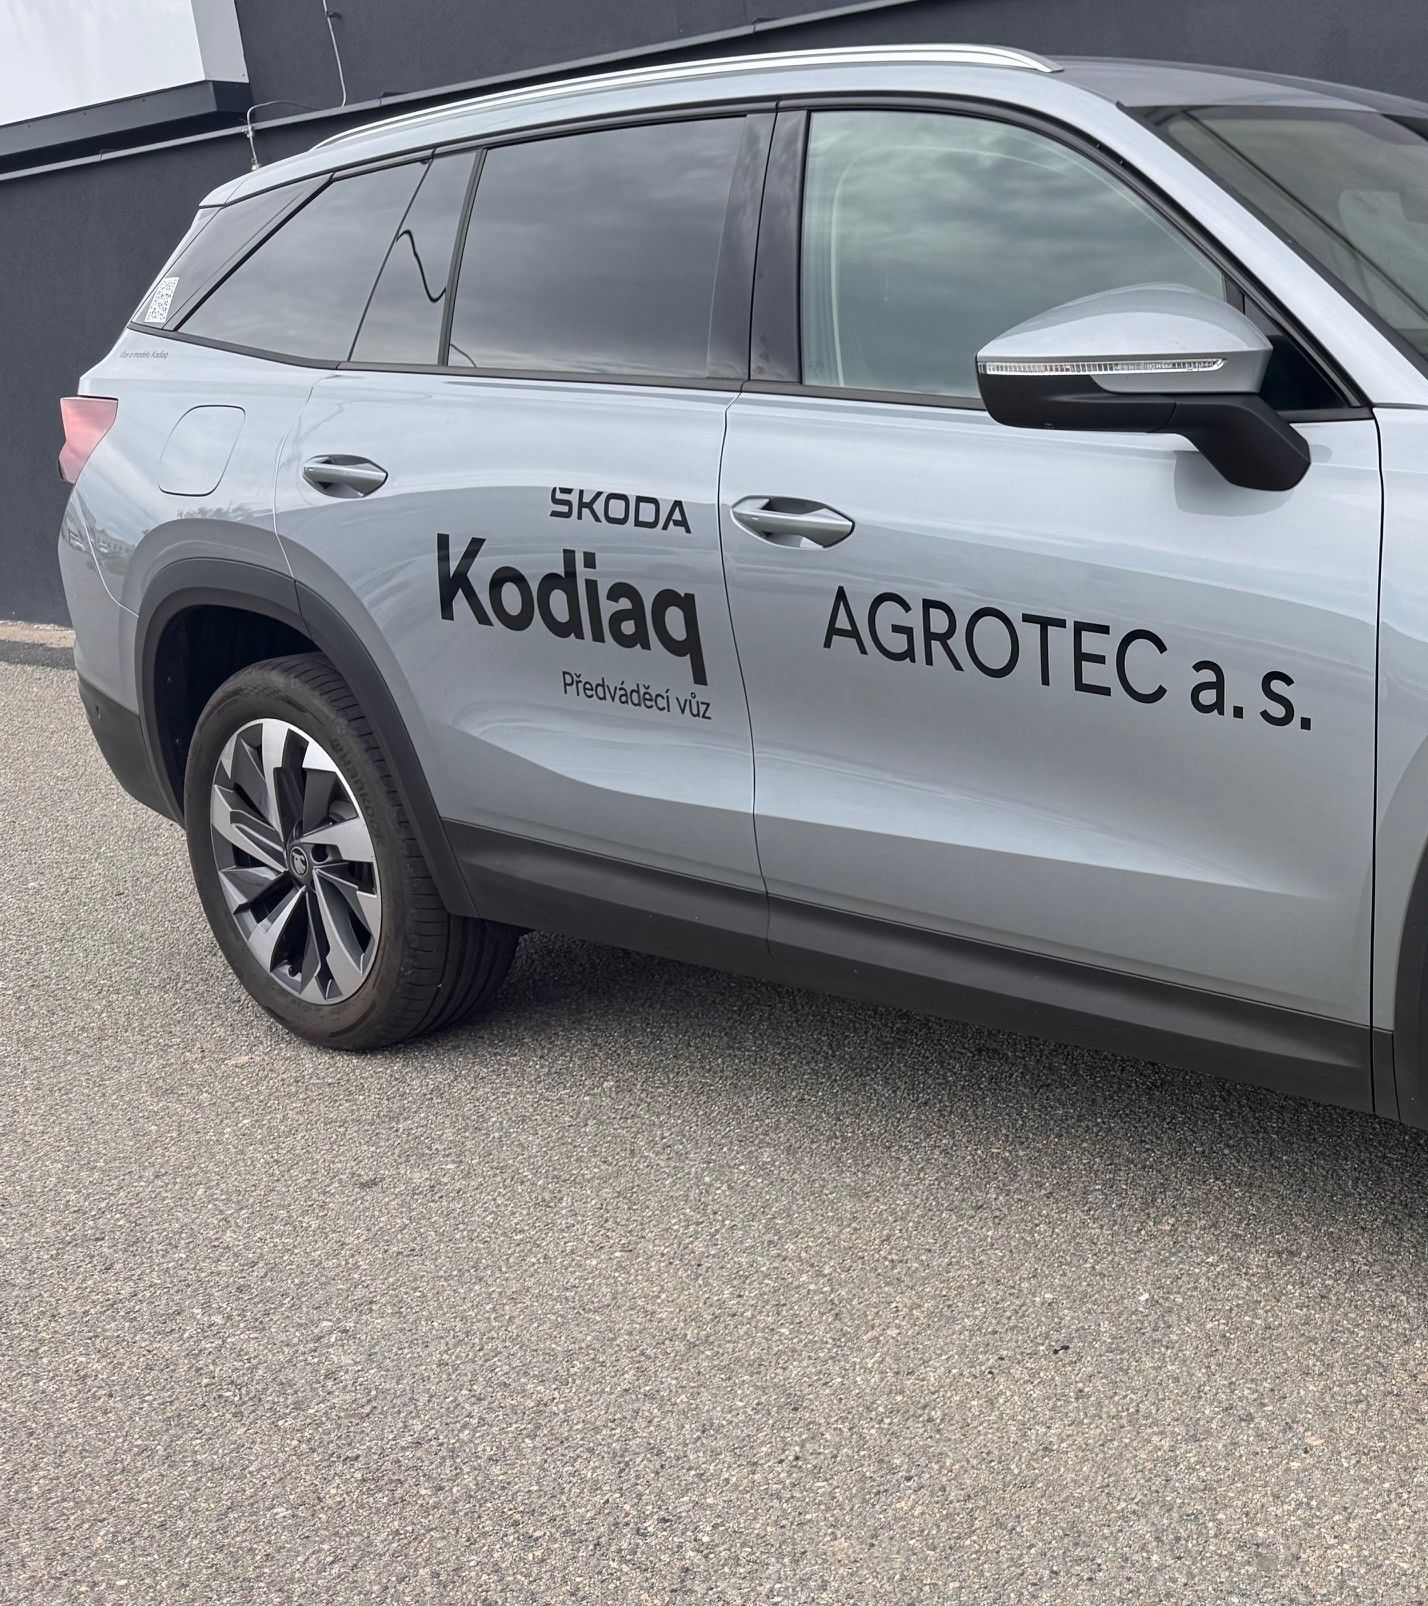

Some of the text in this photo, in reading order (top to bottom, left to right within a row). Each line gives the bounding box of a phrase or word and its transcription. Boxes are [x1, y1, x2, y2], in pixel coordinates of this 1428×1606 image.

[436, 533, 708, 686] Kodiaq
[822, 585, 1169, 704] AGROTEC
[561, 670, 713, 721] Předváděcí vůz
